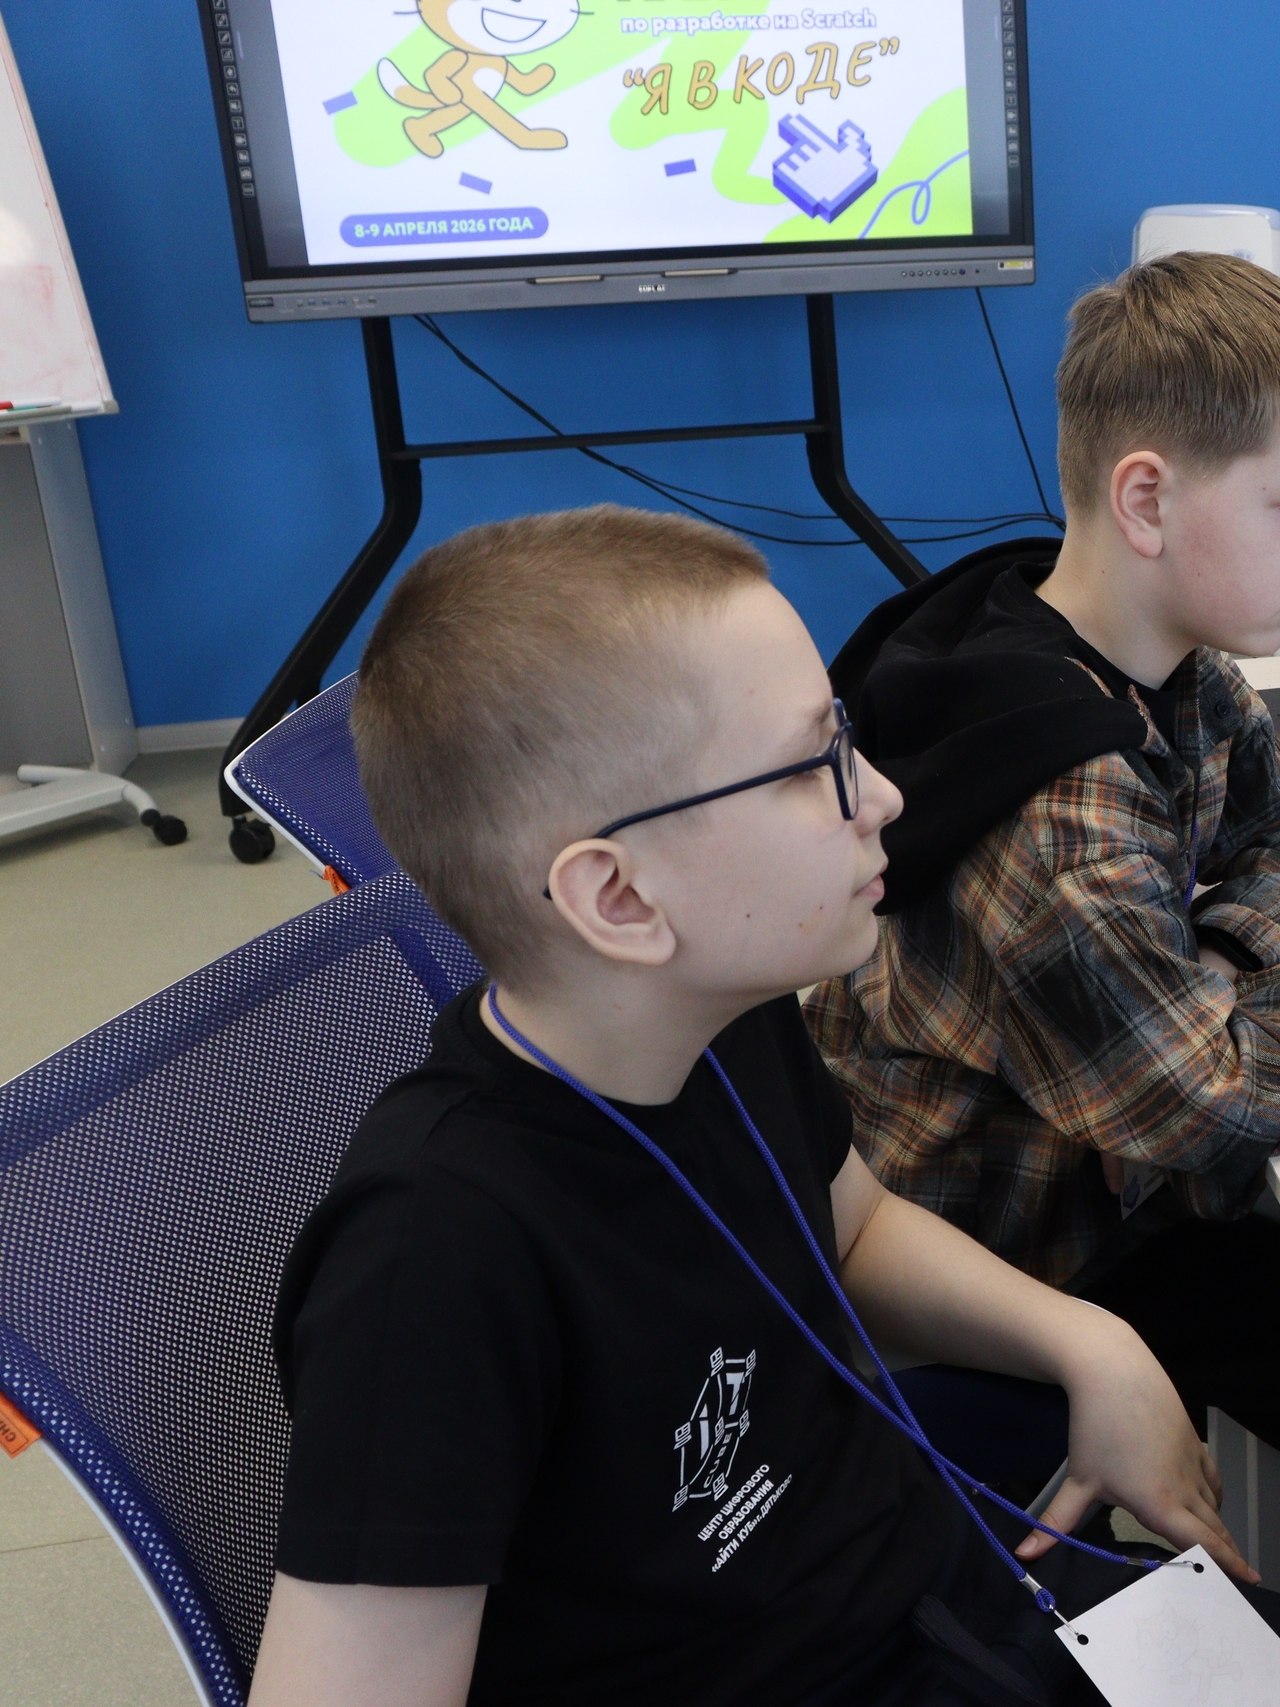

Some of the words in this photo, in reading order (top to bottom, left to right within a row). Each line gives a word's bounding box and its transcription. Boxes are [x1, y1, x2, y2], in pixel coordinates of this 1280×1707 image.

[620, 16, 648, 33] по
[652, 10, 771, 37] разработке
[773, 13, 798, 30] на
[801, 8, 877, 29] Scratch
[687, 60, 718, 110] В
[354, 223, 380, 238] 8-9
[383, 220, 448, 237] АПРЕЛЯ
[451, 218, 487, 234] 2026
[489, 216, 534, 232] ГОДА
[697, 1513, 724, 1541] ЦЕНТР
[720, 1464, 770, 1516] ЦИФРОВОГО
[718, 1479, 775, 1540] ОБРАЗОВАНИЯ
[711, 1538, 740, 1573] «АЙТИ
